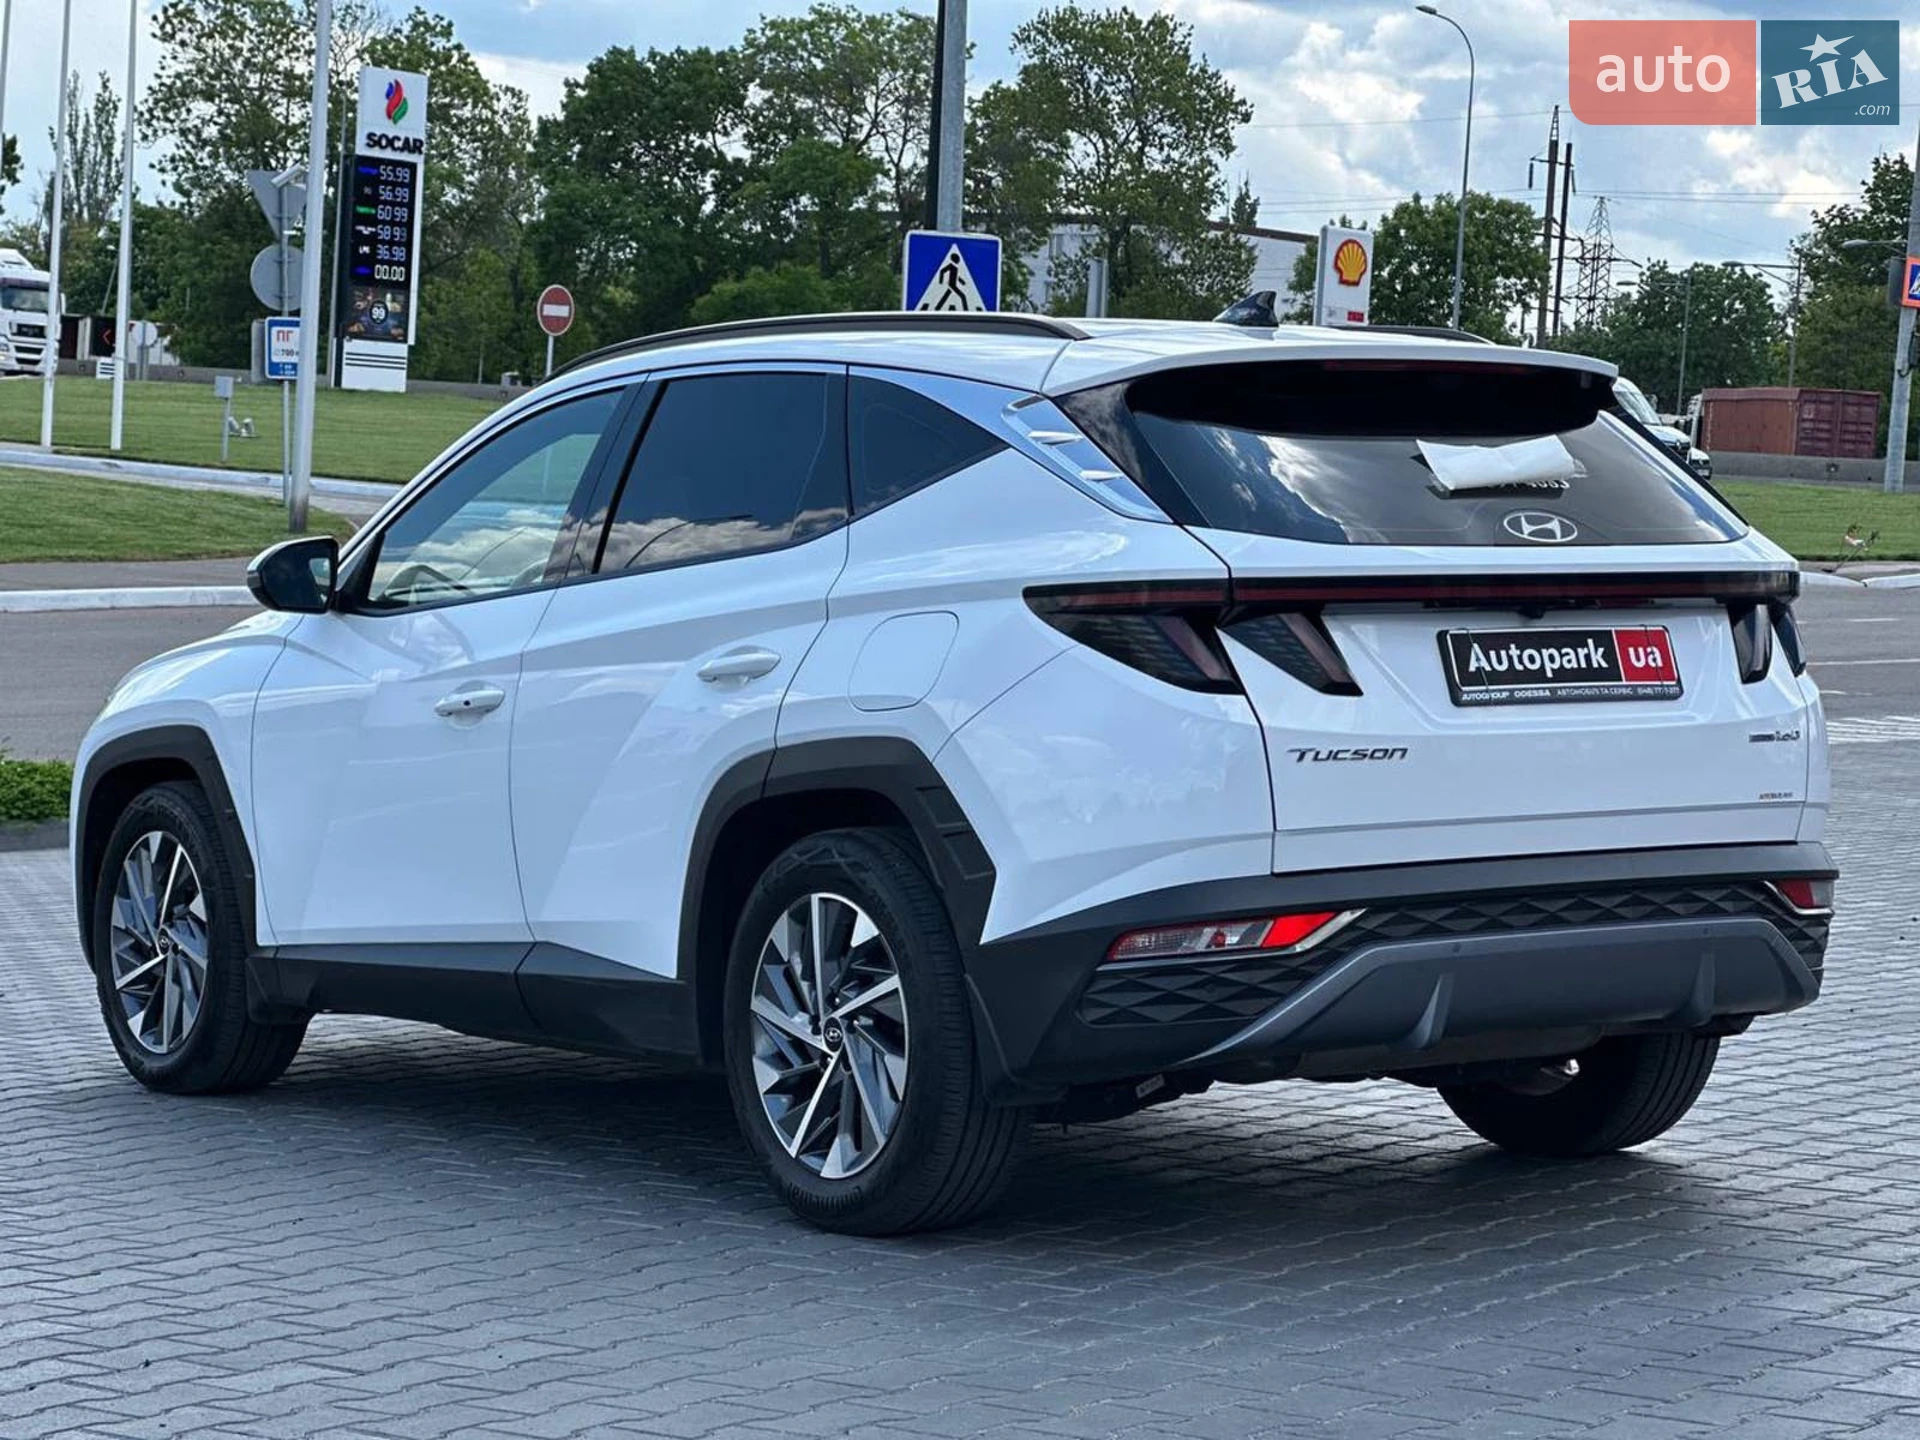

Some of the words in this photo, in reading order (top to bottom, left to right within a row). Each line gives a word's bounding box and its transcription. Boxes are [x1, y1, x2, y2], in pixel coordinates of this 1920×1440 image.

[366, 131, 424, 155] SOCAR
[374, 264, 405, 281] 00.00
[371, 307, 386, 320] 99
[1468, 638, 1609, 678] Autopark
[1627, 645, 1664, 669] ua
[1513, 688, 1552, 698] ODESSA
